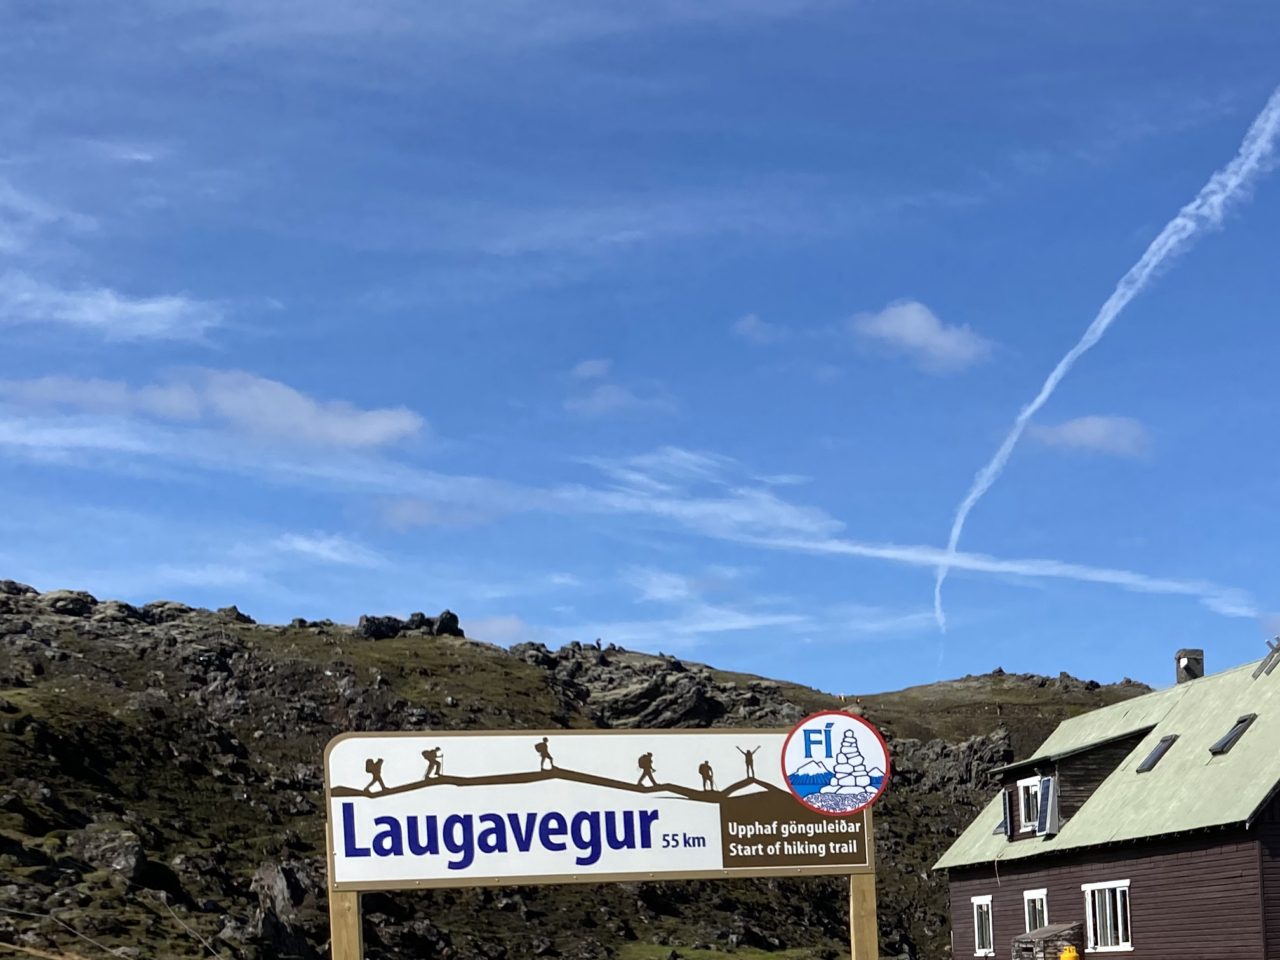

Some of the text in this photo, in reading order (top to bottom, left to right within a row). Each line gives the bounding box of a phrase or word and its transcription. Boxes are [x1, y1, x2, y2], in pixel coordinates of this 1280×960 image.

[803, 722, 835, 759] FÍ
[341, 802, 659, 870] Laugavegur
[728, 819, 861, 838] Upphaf gönguleiðar
[661, 832, 706, 848] 55 km
[729, 839, 858, 857] Start of hiking trail
